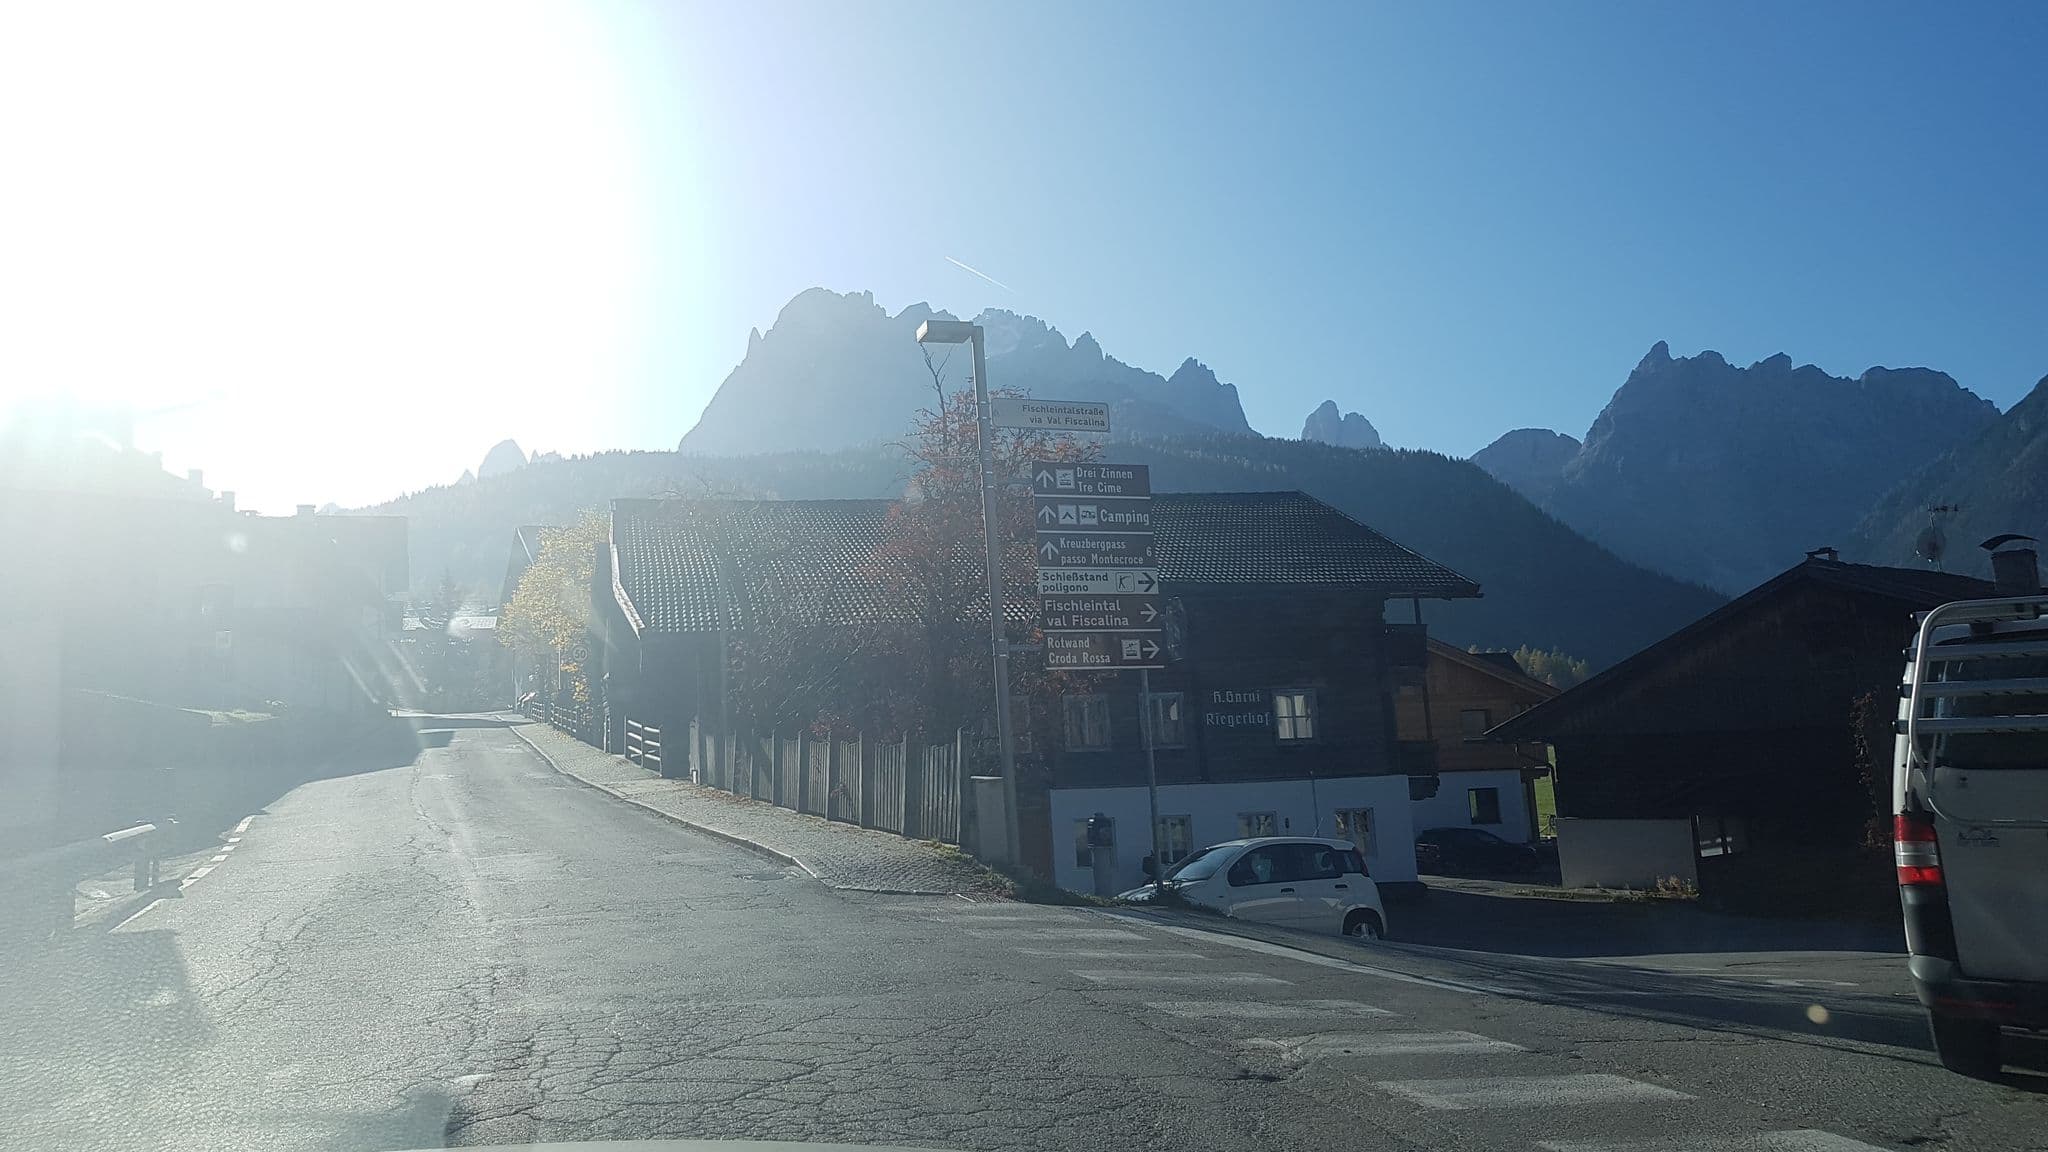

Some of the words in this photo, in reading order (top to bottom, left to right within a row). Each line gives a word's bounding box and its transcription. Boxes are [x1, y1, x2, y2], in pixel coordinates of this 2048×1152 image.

[1022, 405, 1104, 415] Fischleintalstraße
[1029, 416, 1042, 424] via
[1047, 416, 1061, 425] Val
[1065, 417, 1105, 426] Fiscalina
[1076, 467, 1096, 478] Drei
[1100, 468, 1133, 479] Zinnen
[1078, 482, 1093, 492] Tre
[1097, 482, 1122, 492] Cime
[1100, 509, 1149, 525] Camping
[1060, 538, 1126, 551] Kreuzbergpass
[1146, 547, 1152, 556] 6
[1061, 555, 1087, 565] passo
[1091, 554, 1144, 564] Montecroce
[1042, 572, 1108, 581] Schießstand
[1042, 582, 1089, 593] poligono
[1045, 600, 1121, 611] Fischleintal
[1047, 616, 1067, 626] val
[1072, 615, 1129, 626] Fiscalina
[1047, 637, 1090, 649] Rotwand
[1048, 652, 1077, 664] Croda
[1082, 652, 1111, 663] Rossa
[1206, 712, 1270, 727] Riegerhof
